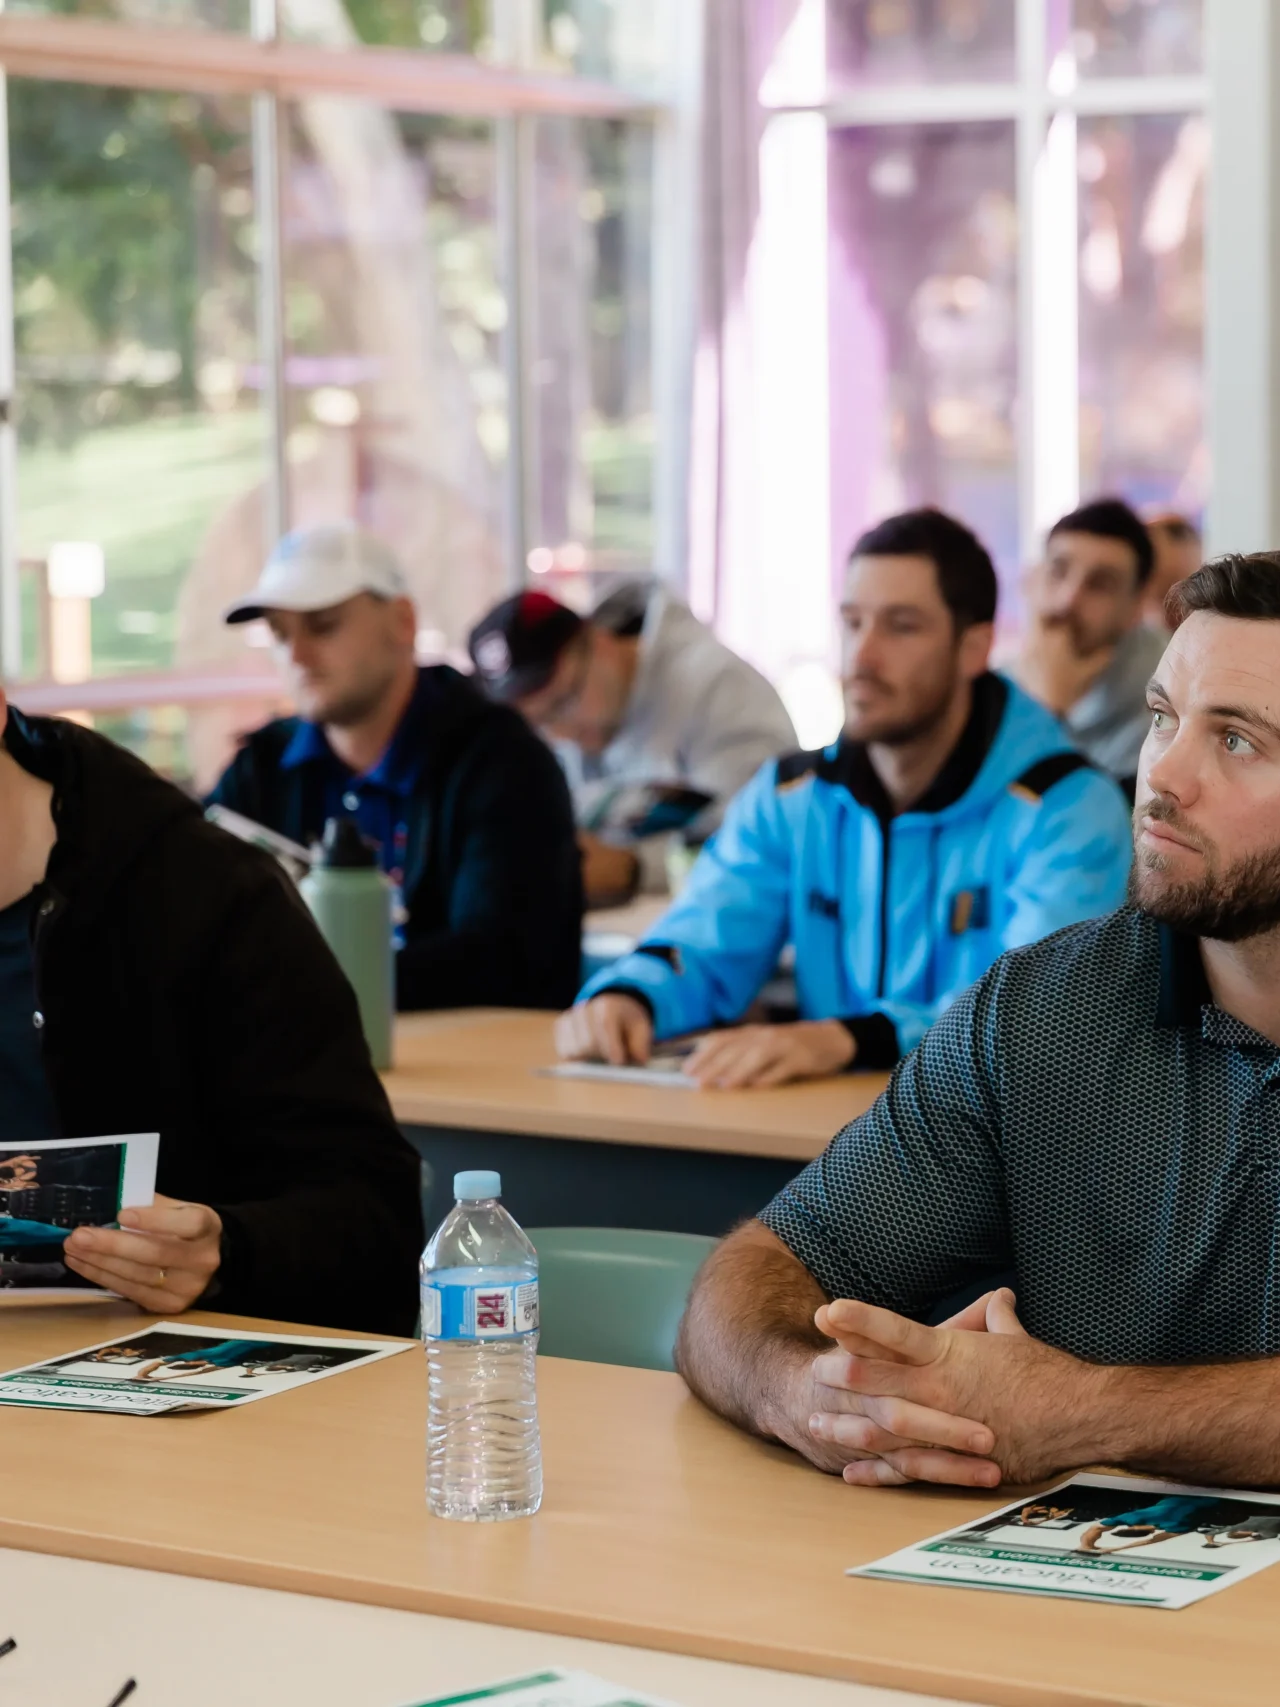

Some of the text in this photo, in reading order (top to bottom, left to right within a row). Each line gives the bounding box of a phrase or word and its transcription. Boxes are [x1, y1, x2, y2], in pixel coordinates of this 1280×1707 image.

[12, 1376, 229, 1399] Exercise Progression Chart
[939, 1545, 1204, 1579] Exercise Progression Chart
